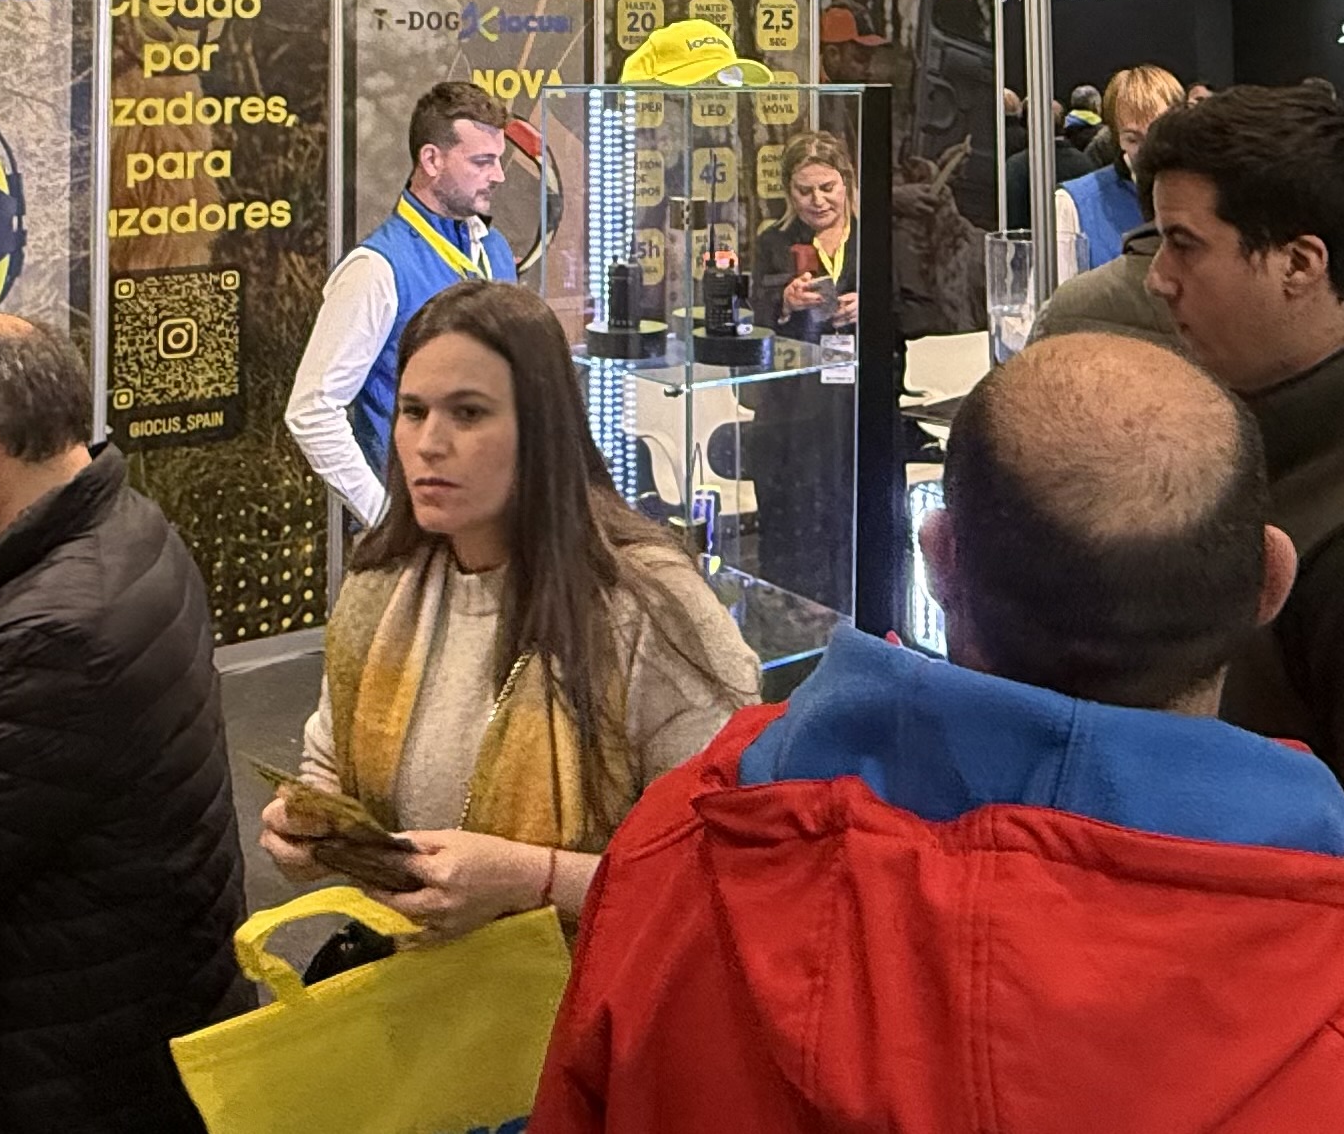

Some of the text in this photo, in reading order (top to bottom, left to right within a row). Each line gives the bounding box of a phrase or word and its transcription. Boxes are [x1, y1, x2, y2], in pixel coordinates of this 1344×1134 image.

[626, 12, 656, 32] 20
[762, 9, 794, 34] 2,5
[144, 42, 220, 78] por
[472, 68, 567, 99] NOVA
[112, 91, 299, 128] zadores,
[127, 149, 232, 188] para
[108, 198, 292, 238] zadores
